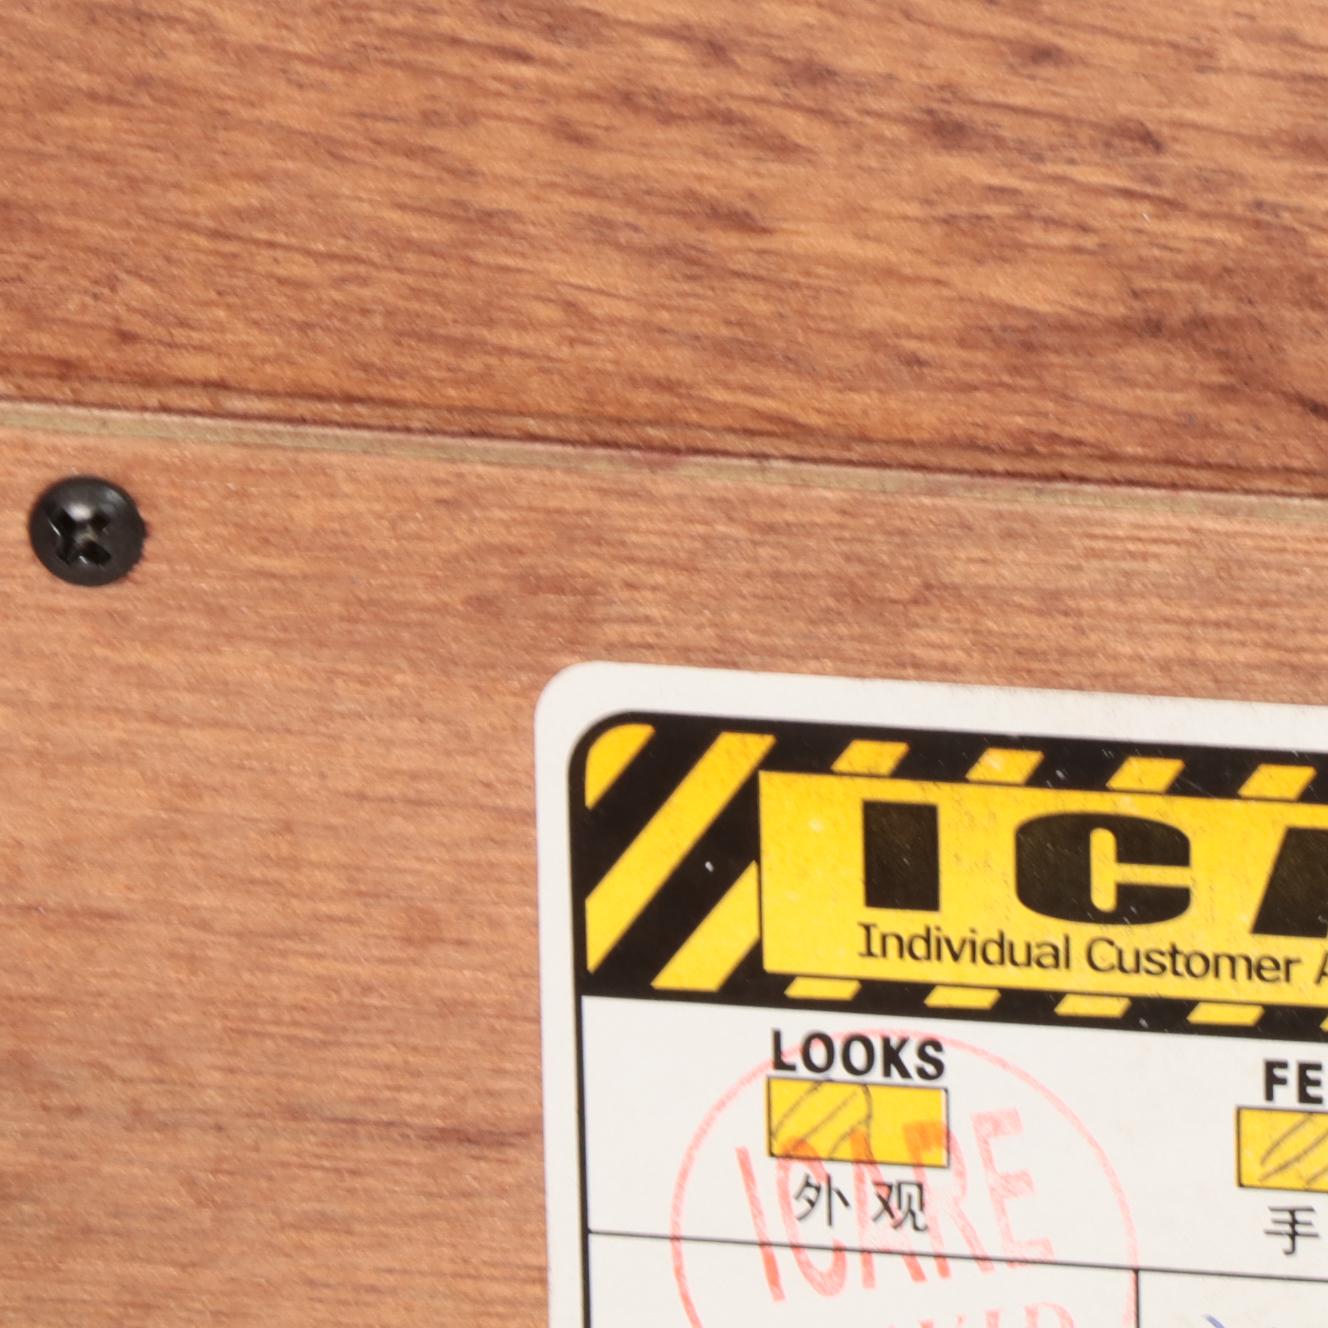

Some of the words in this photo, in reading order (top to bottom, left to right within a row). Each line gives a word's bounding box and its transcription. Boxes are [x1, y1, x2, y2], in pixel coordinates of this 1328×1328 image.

[857, 921, 1072, 971] Individual
[1084, 936, 1301, 984] Customer
[771, 1028, 946, 1080] LOOKS
[795, 1174, 929, 1232] 外观
